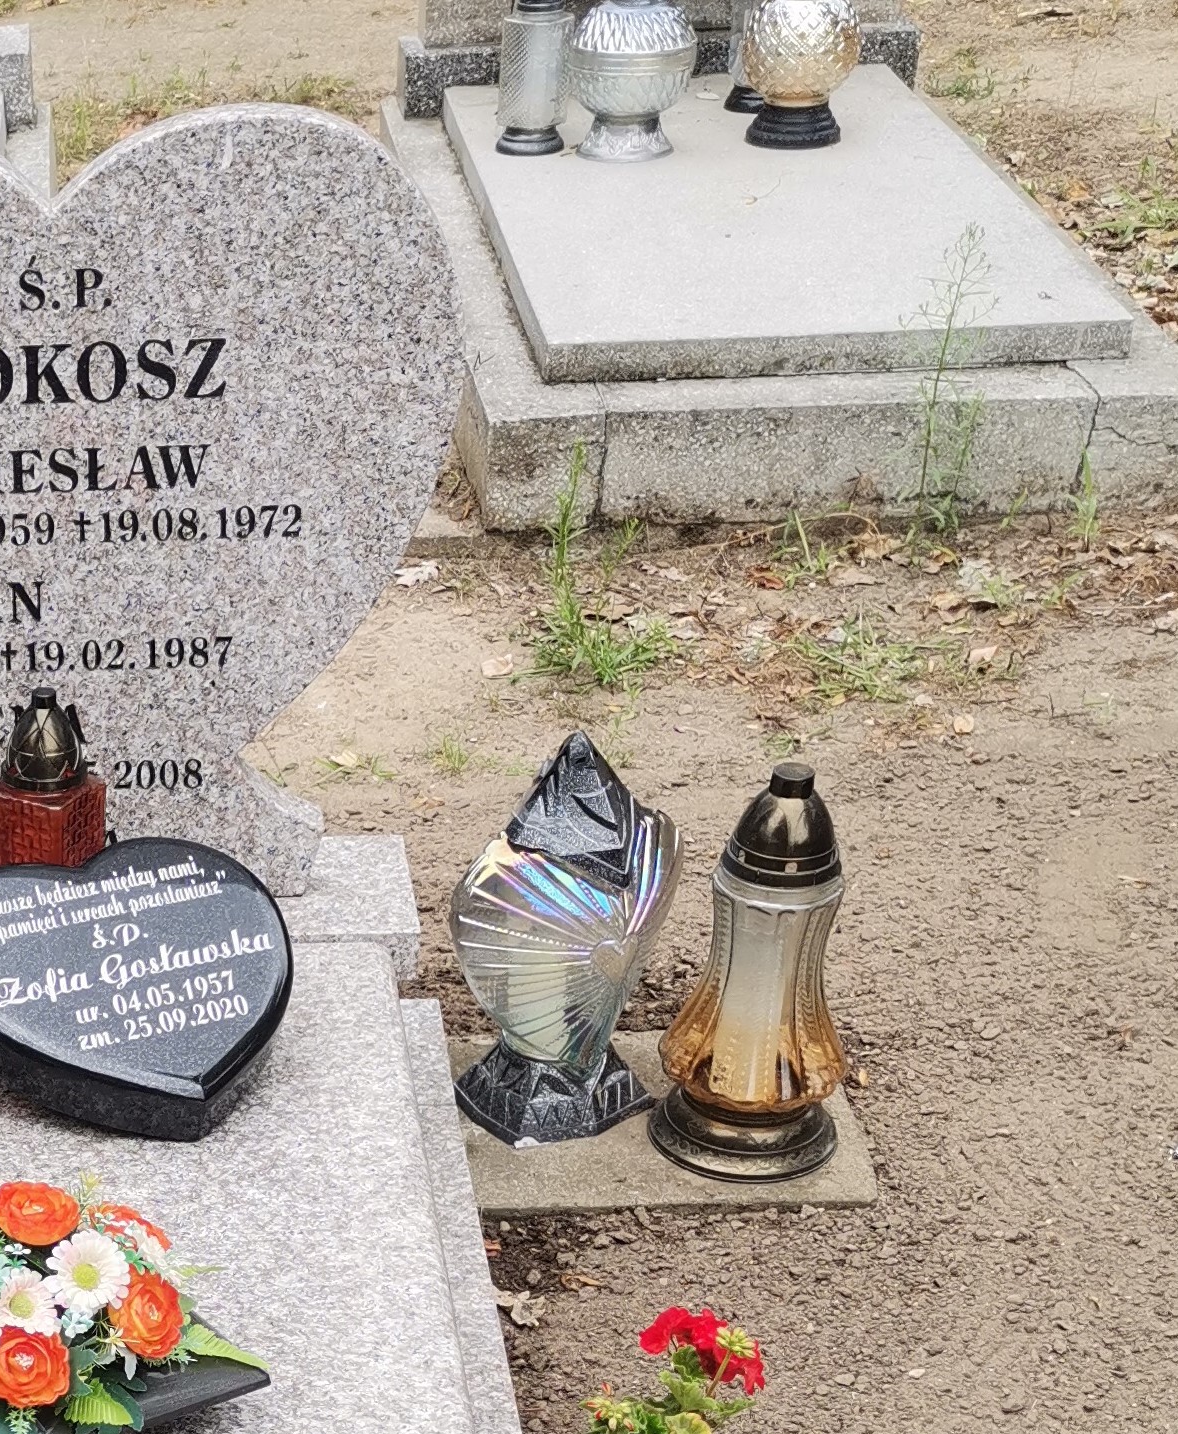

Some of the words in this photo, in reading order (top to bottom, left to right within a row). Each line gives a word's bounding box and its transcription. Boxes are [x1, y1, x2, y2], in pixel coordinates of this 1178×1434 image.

[98, 929, 276, 990] Gosławska
[75, 1004, 109, 1024] ur.
[111, 969, 236, 1016] 04.05.1957
[77, 1030, 121, 1052] zm.
[124, 994, 250, 1041] 25.09.2020
